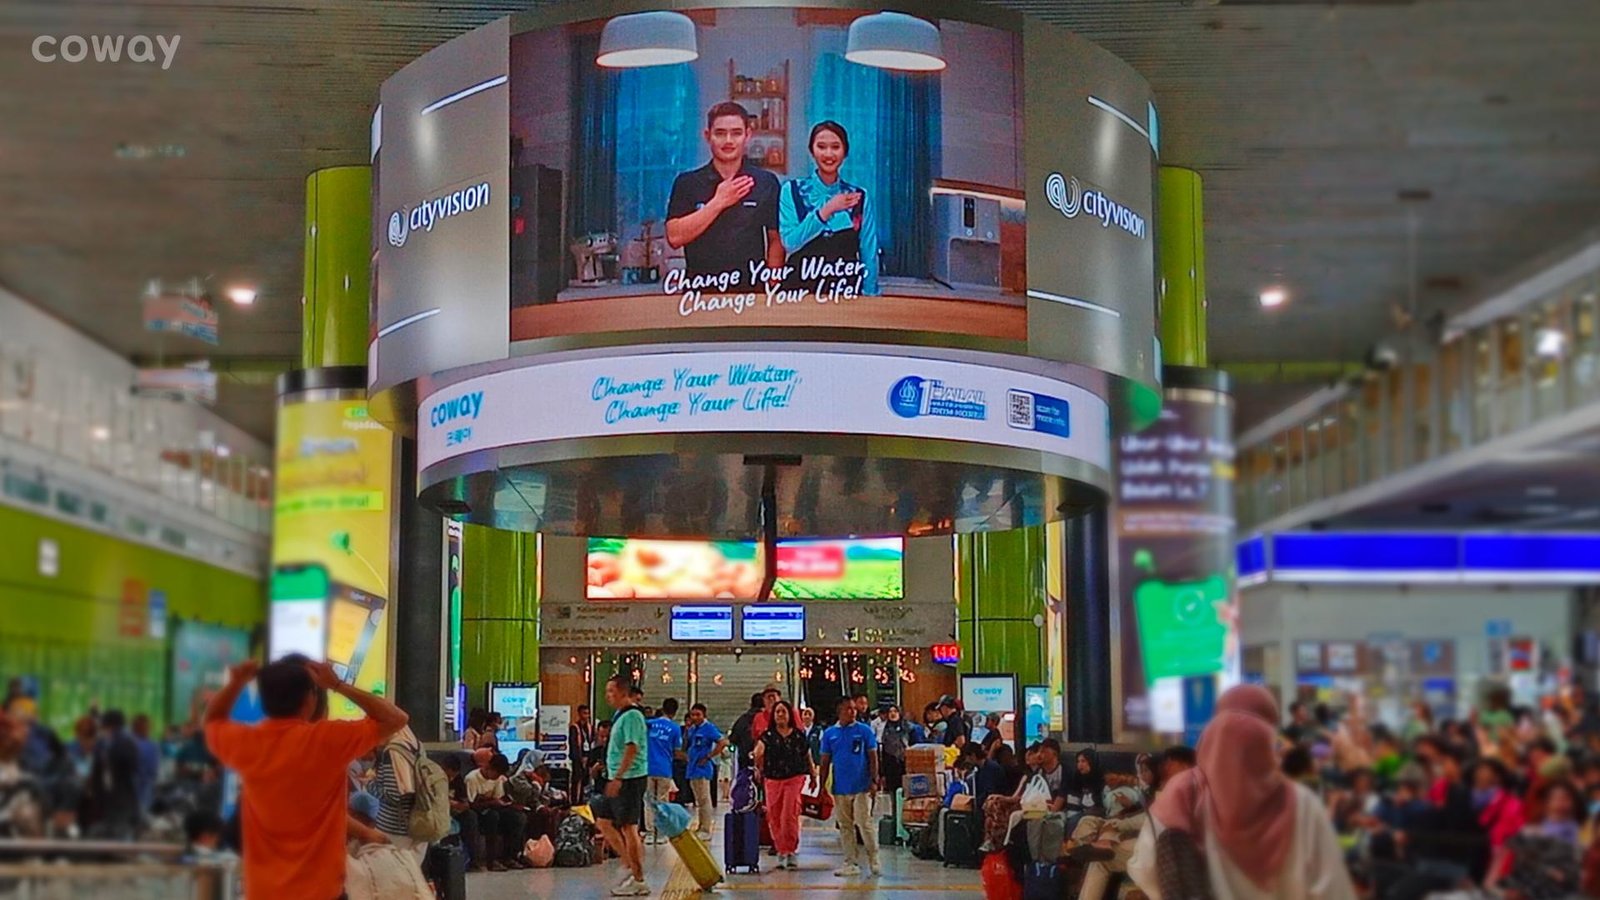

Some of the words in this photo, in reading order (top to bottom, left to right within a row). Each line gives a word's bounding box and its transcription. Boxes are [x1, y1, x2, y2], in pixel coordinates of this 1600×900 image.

[410, 182, 490, 232] cityvision
[1083, 190, 1146, 240] cityvision
[664, 269, 740, 294] Change
[749, 260, 794, 286] Your
[801, 256, 868, 281] Water,
[678, 291, 755, 316] Change
[764, 283, 809, 307] Your
[815, 275, 862, 304] Life!
[591, 376, 665, 401] Change
[673, 367, 720, 391] Your
[430, 390, 484, 428] coway
[605, 399, 680, 424] Change
[688, 392, 736, 416] Your
